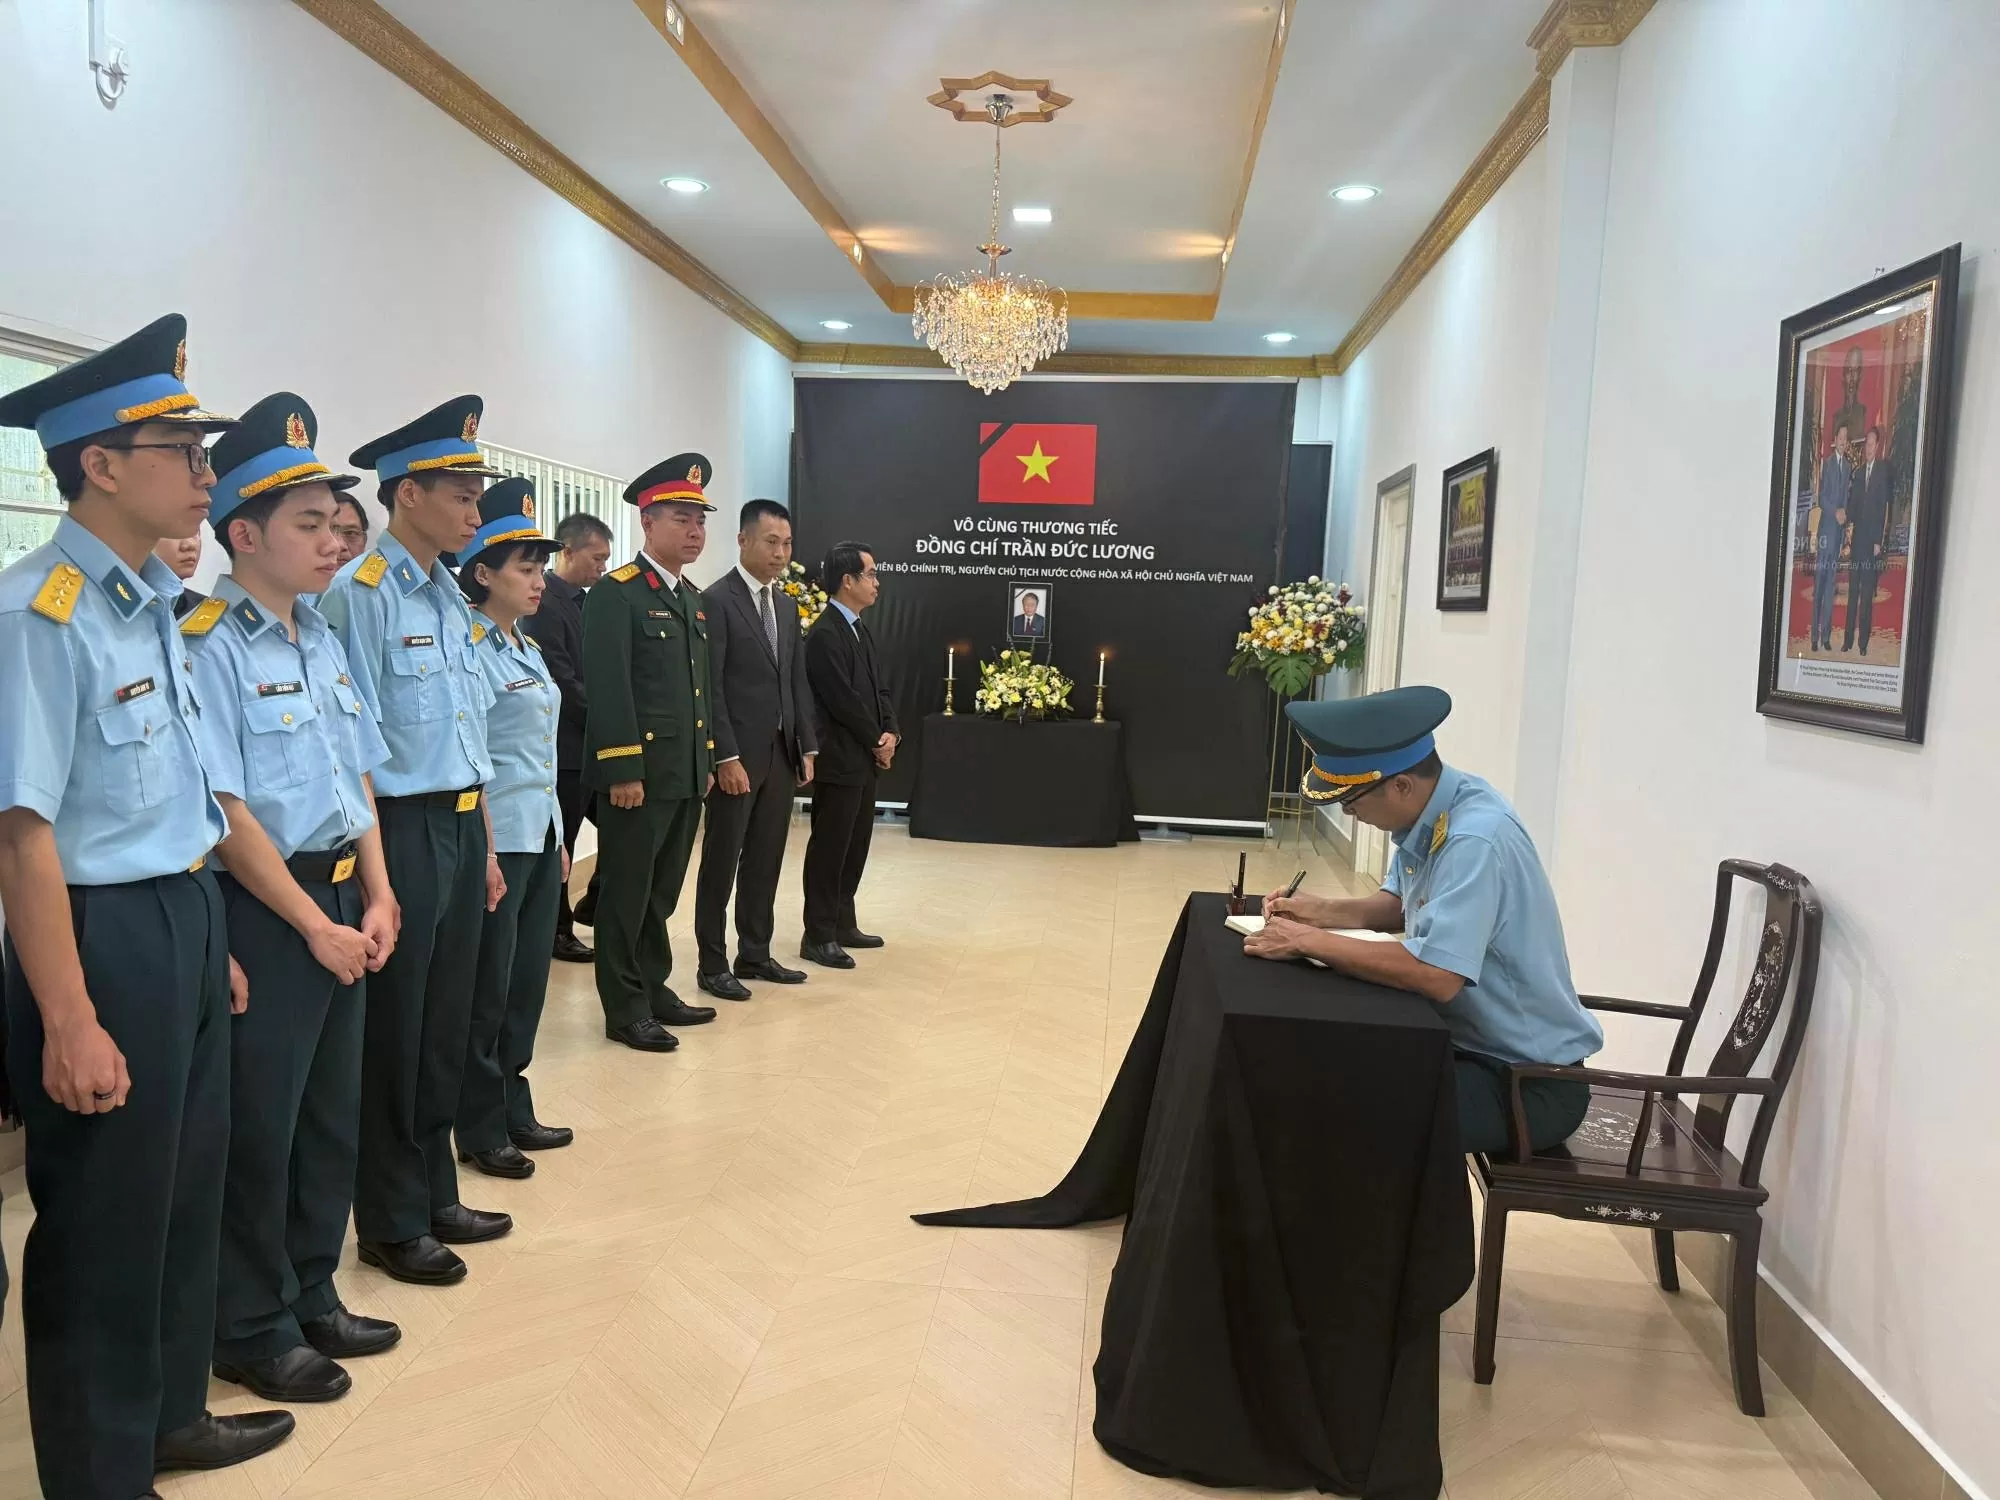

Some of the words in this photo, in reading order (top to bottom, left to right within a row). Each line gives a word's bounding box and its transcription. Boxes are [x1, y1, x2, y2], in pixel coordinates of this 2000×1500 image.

[953, 516, 974, 532] VÔ
[977, 517, 1018, 533] CÙNG
[1020, 521, 1085, 535] THƯƠNG
[1088, 518, 1118, 536] TIẾC
[915, 534, 966, 555] ĐỒNG
[969, 538, 1000, 556] CHÍ
[1001, 537, 1047, 557] TRẦN
[1050, 540, 1088, 558] ĐỨC
[1092, 543, 1155, 560] LƯƠNG
[895, 563, 909, 574] BỘ
[910, 563, 938, 573] CHÍNH
[940, 565, 957, 576] TRỊ,
[958, 565, 996, 575] NGUYÊN
[997, 565, 1017, 576] CHỦ
[1018, 567, 1039, 578] TỊCH
[1040, 566, 1069, 577] NƯỚC
[1069, 568, 1097, 579] CỘNG
[1098, 568, 1119, 579] HÒA
[1120, 569, 1133, 579] XÃ
[1134, 570, 1152, 581] HỘI
[1153, 569, 1174, 581] CHỦ
[1175, 571, 1206, 582] NGHĨA
[1207, 571, 1229, 583] VIỆT
[1229, 574, 1254, 583] NAM
